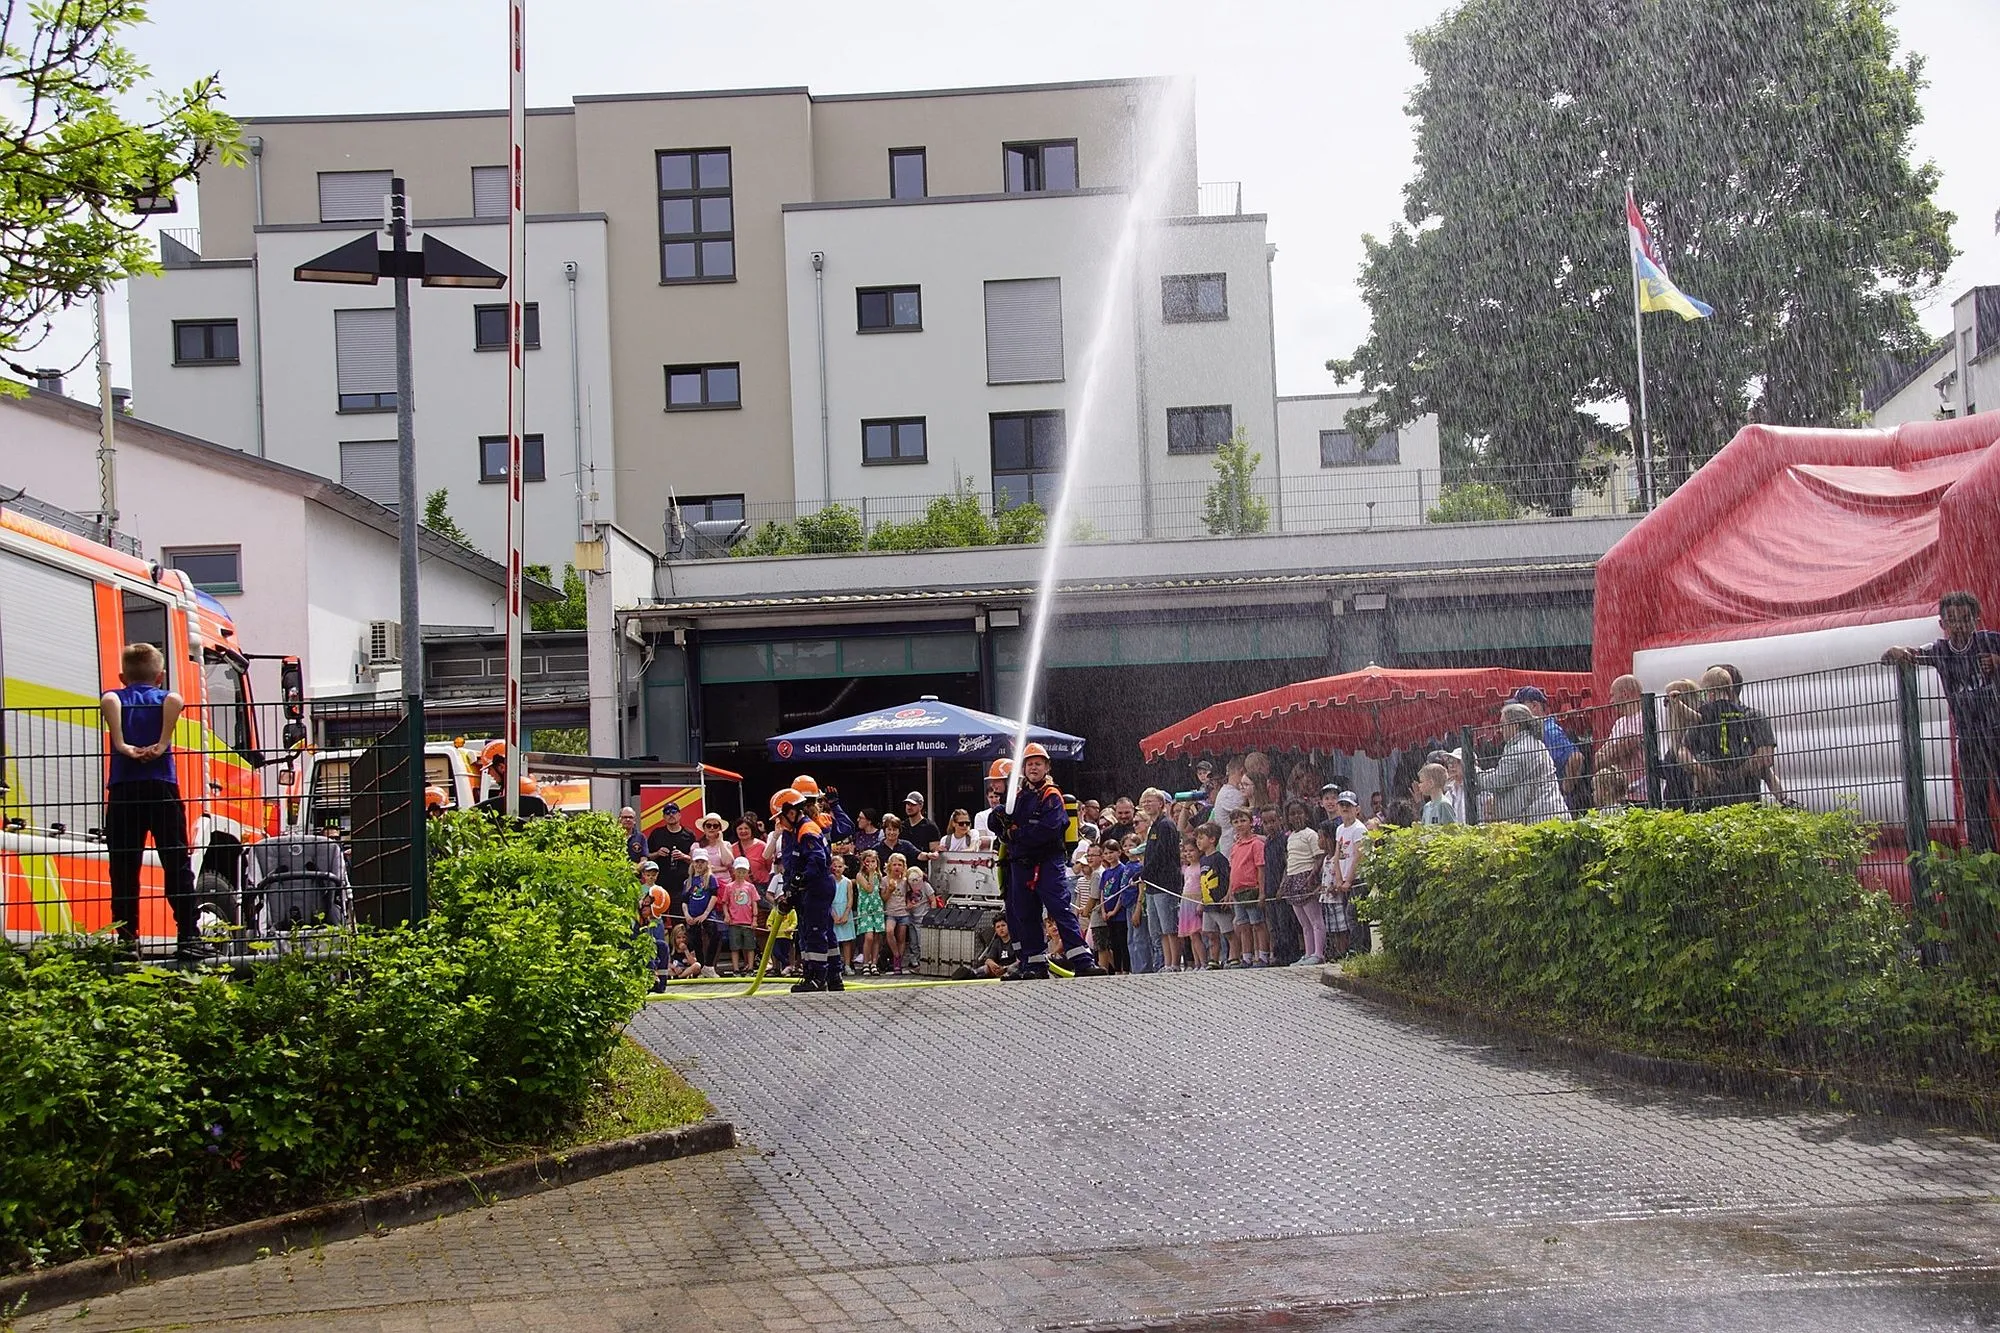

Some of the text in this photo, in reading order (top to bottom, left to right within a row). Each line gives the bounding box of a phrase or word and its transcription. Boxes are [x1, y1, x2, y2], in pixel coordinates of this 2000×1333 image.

[804, 740, 948, 753] Seit Jahrhunderten in aller Munde.
